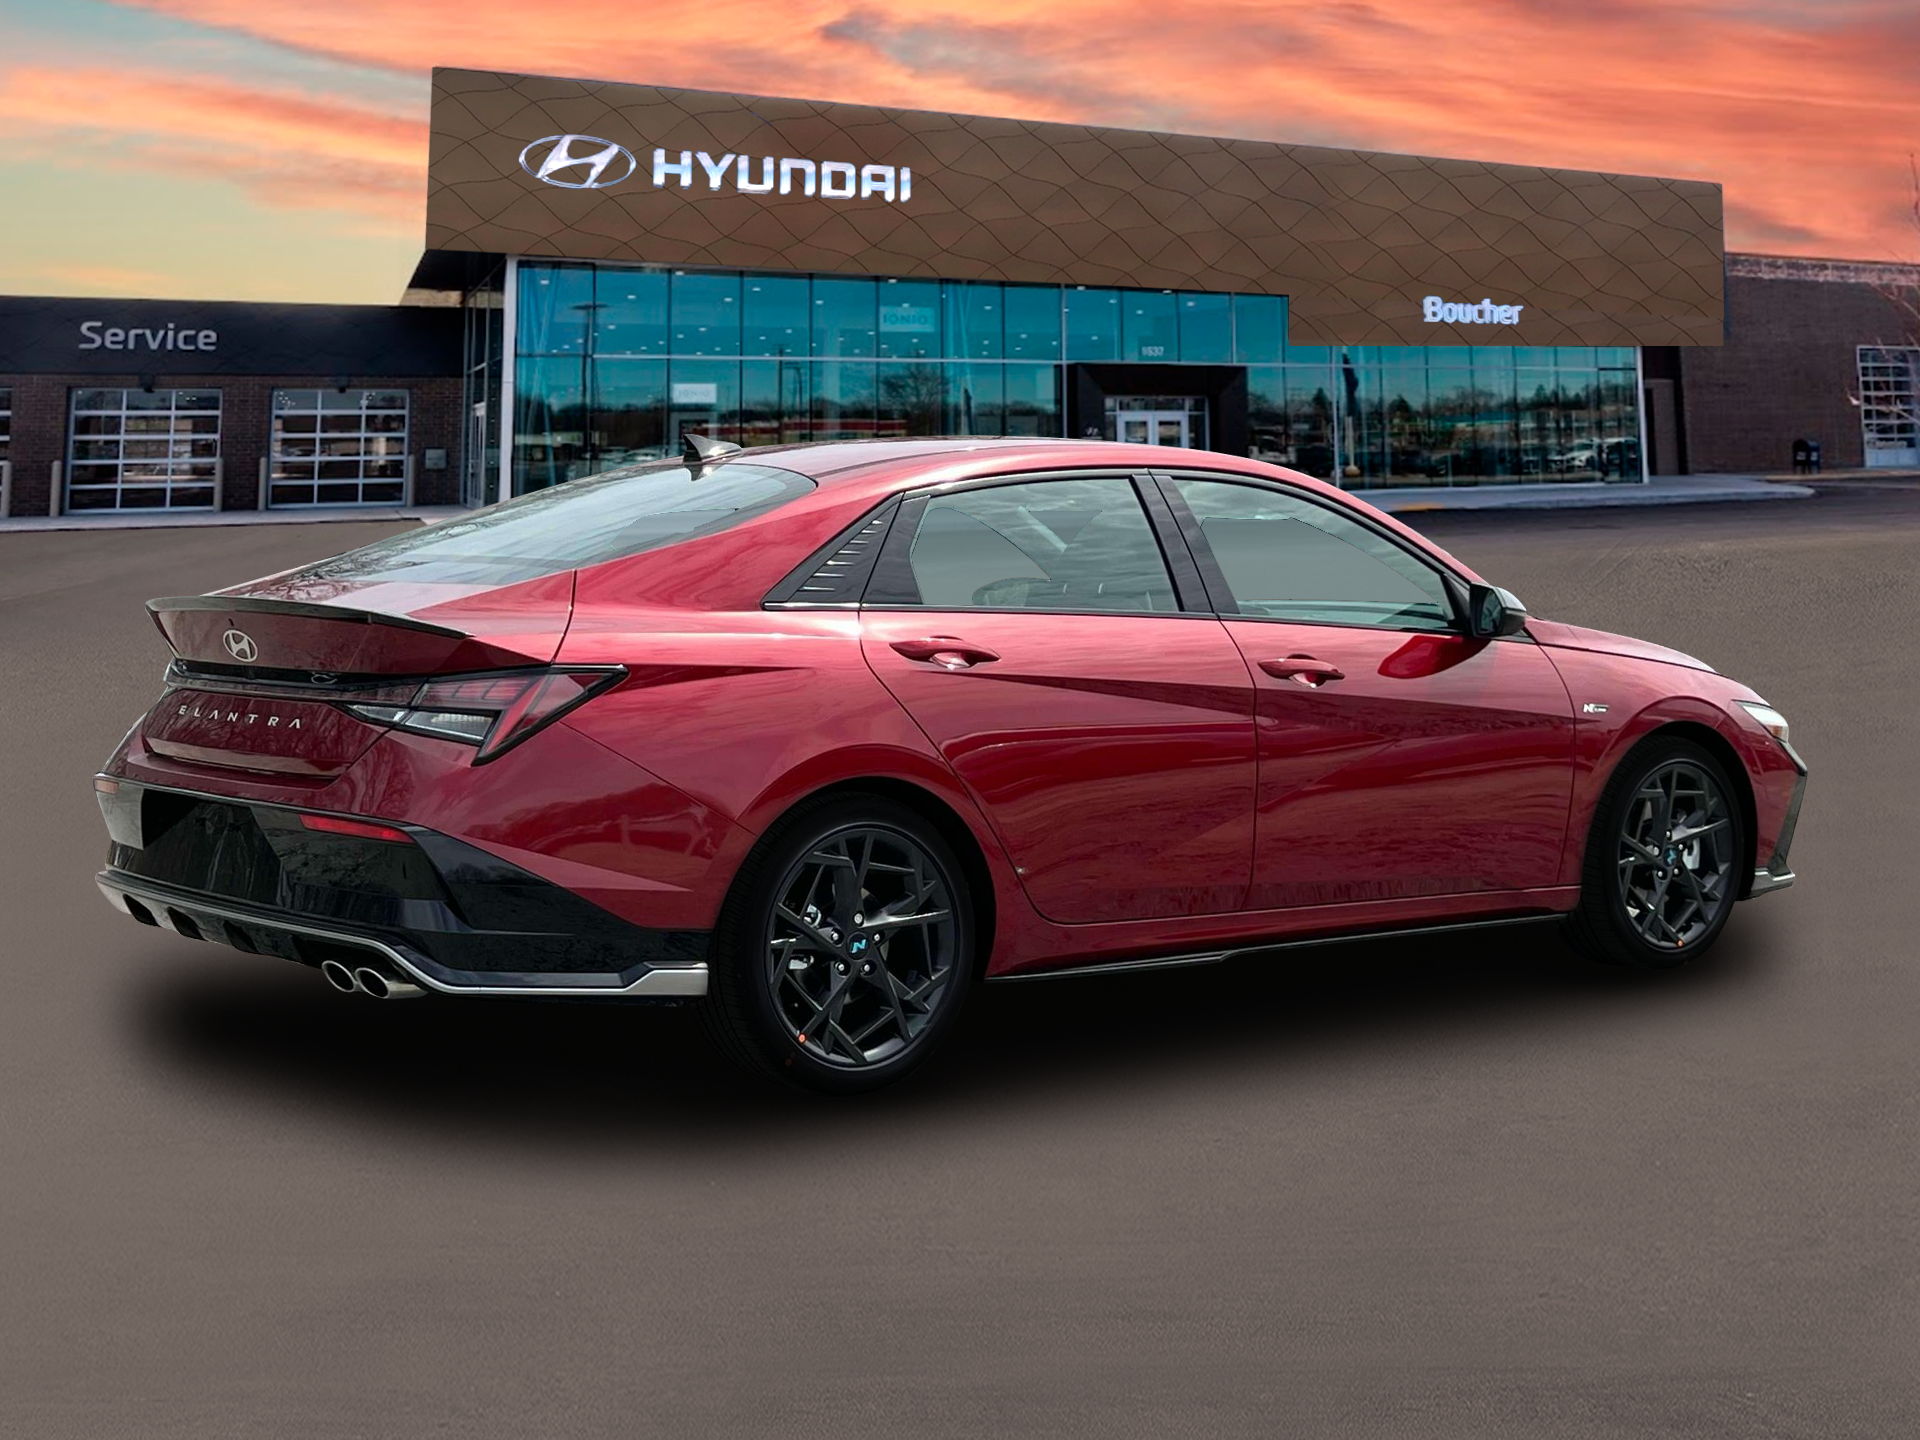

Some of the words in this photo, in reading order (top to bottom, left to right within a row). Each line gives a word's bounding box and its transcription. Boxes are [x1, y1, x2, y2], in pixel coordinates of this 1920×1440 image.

[652, 148, 911, 202] HYUNDAI
[1422, 295, 1524, 325] Boucher
[78, 321, 218, 350] Service
[178, 705, 301, 729] ELANTRA
